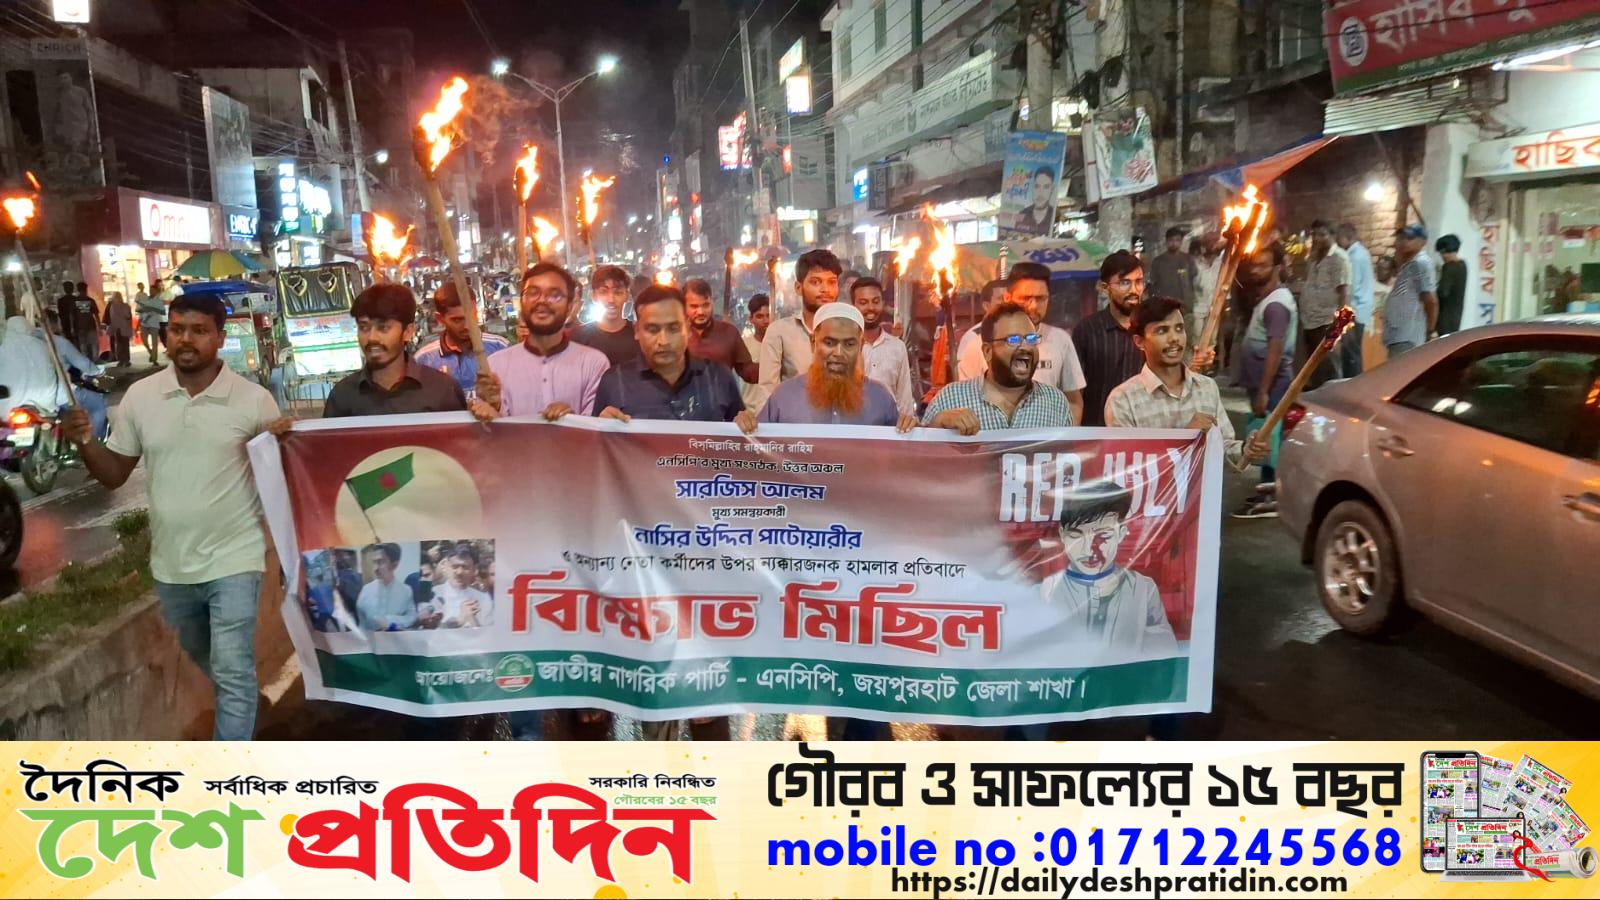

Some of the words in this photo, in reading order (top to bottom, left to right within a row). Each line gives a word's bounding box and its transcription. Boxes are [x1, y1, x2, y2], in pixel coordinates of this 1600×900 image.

[783, 461, 808, 473] উত্তর
[675, 475, 757, 499] সারজিস
[762, 483, 825, 500] আলম
[711, 507, 731, 520] মুখ্য
[635, 524, 690, 547] নাসির
[696, 525, 753, 547] উদ্দিন
[759, 525, 863, 549] পাটোয়ারীর
[621, 556, 654, 571] নেতা
[660, 554, 715, 574] কর্মীদের
[721, 555, 755, 574] উপর
[760, 556, 839, 575] ন্যক্কারজনক
[845, 558, 898, 576] হামলার
[903, 559, 968, 579] প্রতিবাদে
[509, 573, 758, 642] বিক্ষোভ
[782, 583, 1004, 654] মিছিল
[536, 655, 604, 683] জাতীয়
[608, 666, 676, 694] নাগরিক
[685, 660, 731, 692] পার্টি
[756, 663, 844, 697] এনসিপি,
[852, 672, 959, 703] জয়পুরহাট
[967, 679, 1021, 702] জেলা
